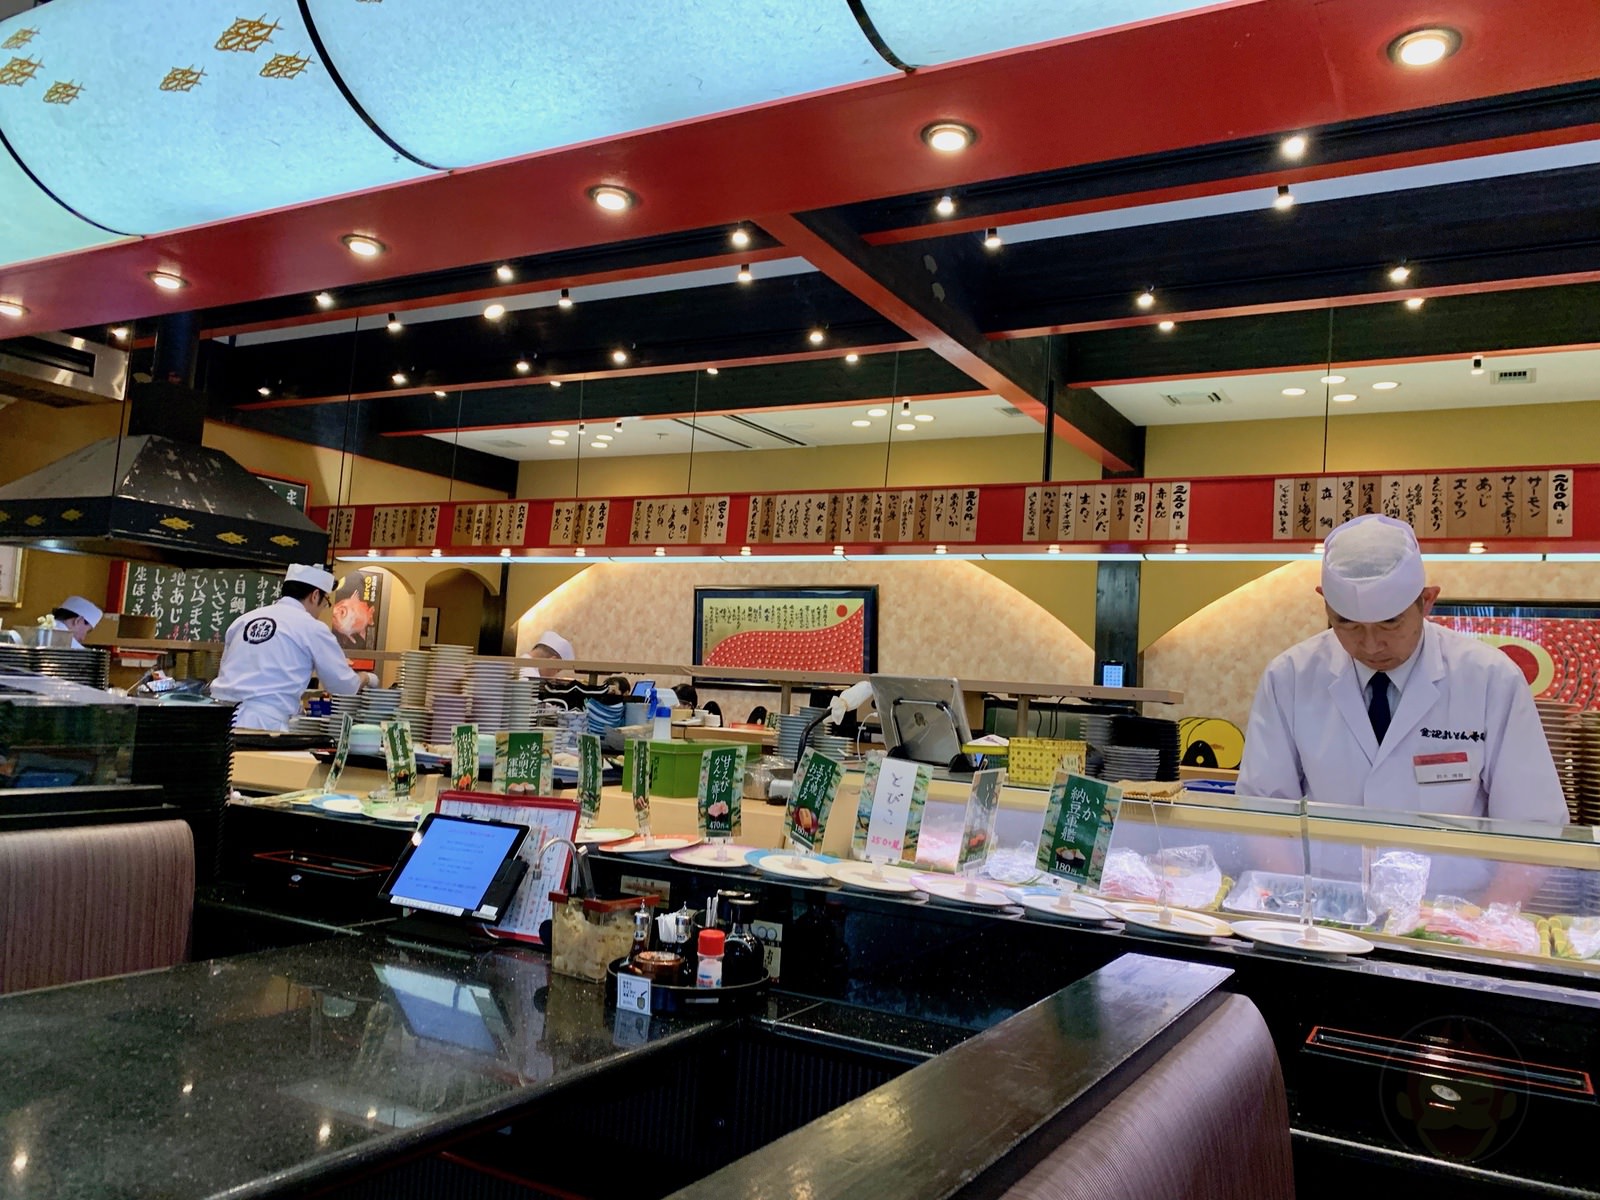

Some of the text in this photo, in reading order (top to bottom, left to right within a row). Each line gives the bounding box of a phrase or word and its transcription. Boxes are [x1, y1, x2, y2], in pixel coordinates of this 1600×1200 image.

[934, 494, 944, 522] ほたて
[1043, 491, 1056, 530] かにみそ
[1080, 492, 1091, 523] 生だこ
[1114, 488, 1127, 521] 数の子
[1155, 487, 1167, 519] 赤えび
[1320, 487, 1333, 528] 真鯛
[1454, 478, 1467, 520] エンガワ
[1476, 477, 1492, 508] あじ
[1501, 475, 1517, 536] サーモンあぶり
[1528, 476, 1542, 518] サーモン
[692, 502, 702, 525] いくら
[1095, 493, 1109, 533] こはだ
[1134, 491, 1146, 534] 明石だこ
[170, 572, 187, 624] 地あじ
[190, 575, 207, 640] ひらまさ
[210, 578, 229, 631] いさき
[508, 757, 518, 777] 軍艦
[519, 745, 529, 778] いか明太
[530, 742, 540, 778] あごだし
[721, 755, 732, 792] 甘えび
[883, 772, 904, 825] とびこ
[1060, 787, 1086, 843] 納豆軍艦
[1082, 794, 1100, 821] いか
